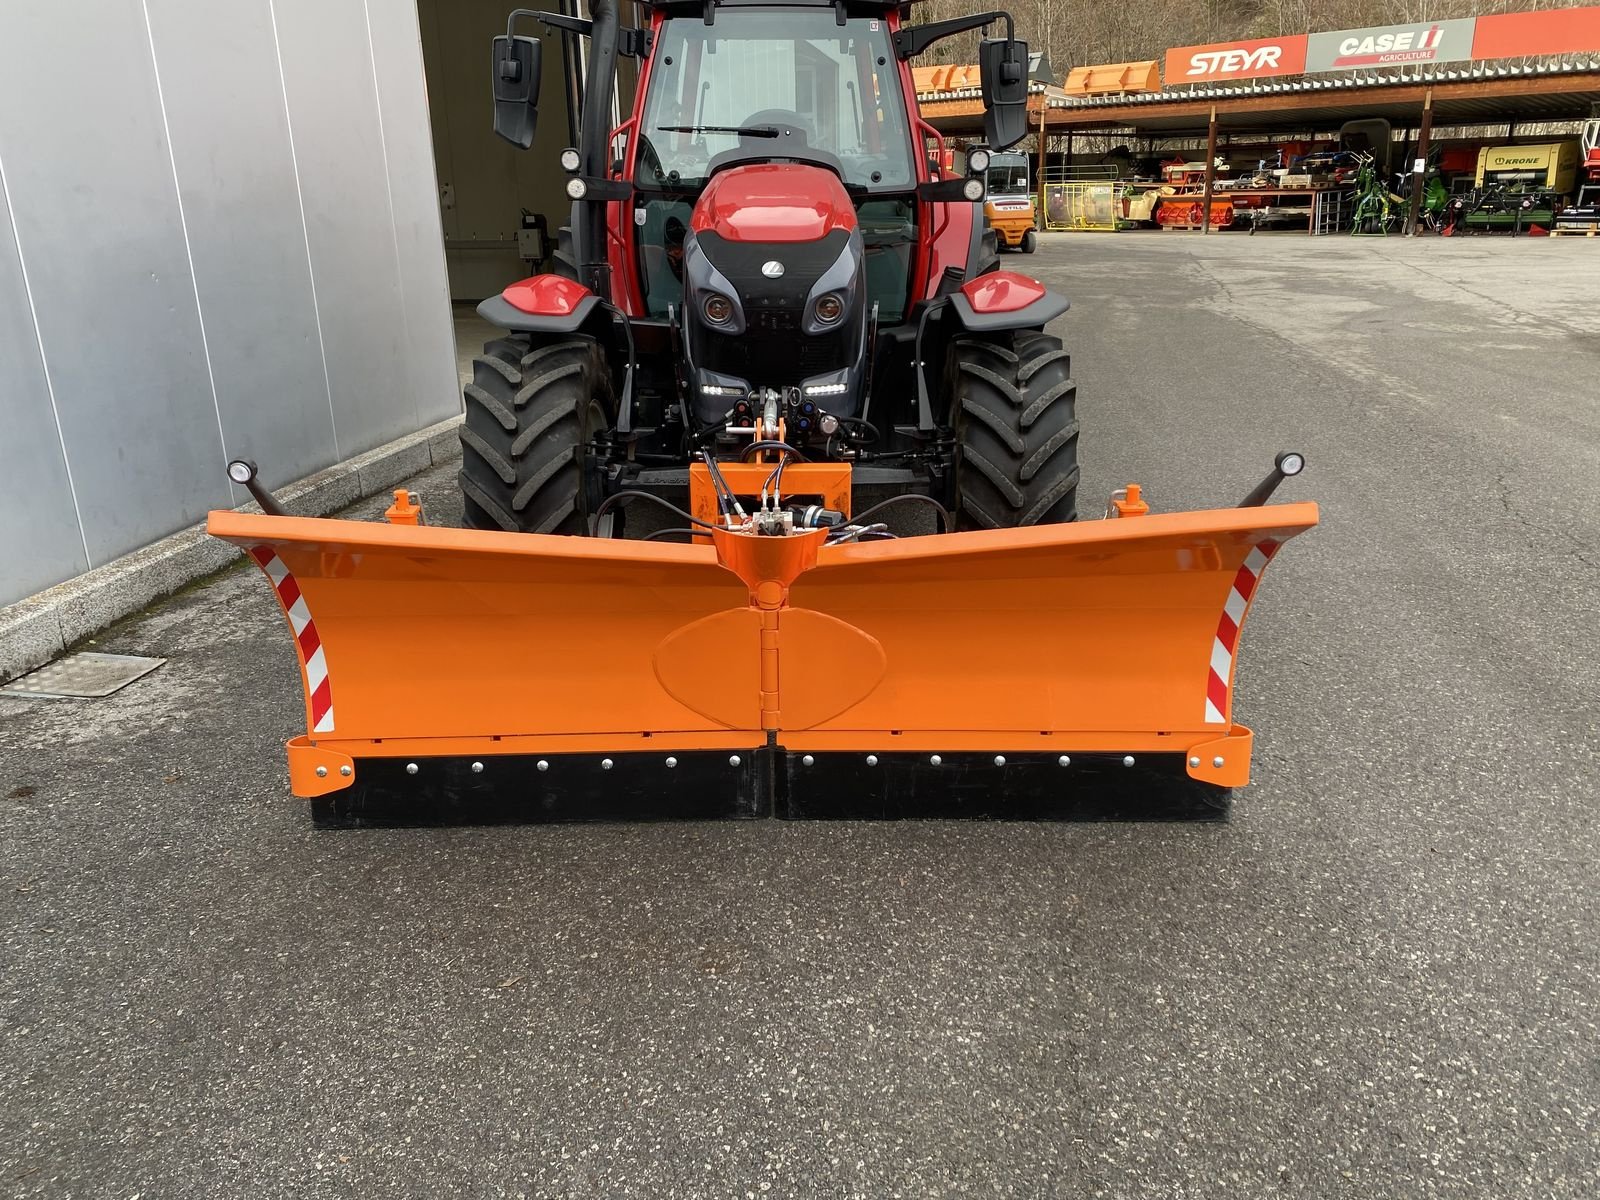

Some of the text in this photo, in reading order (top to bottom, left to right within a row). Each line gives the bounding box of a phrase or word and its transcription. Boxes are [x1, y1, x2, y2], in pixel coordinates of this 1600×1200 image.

[1339, 31, 1415, 56] CASE
[1186, 46, 1282, 75] STEYR
[1379, 50, 1432, 63] AGRICULTURE
